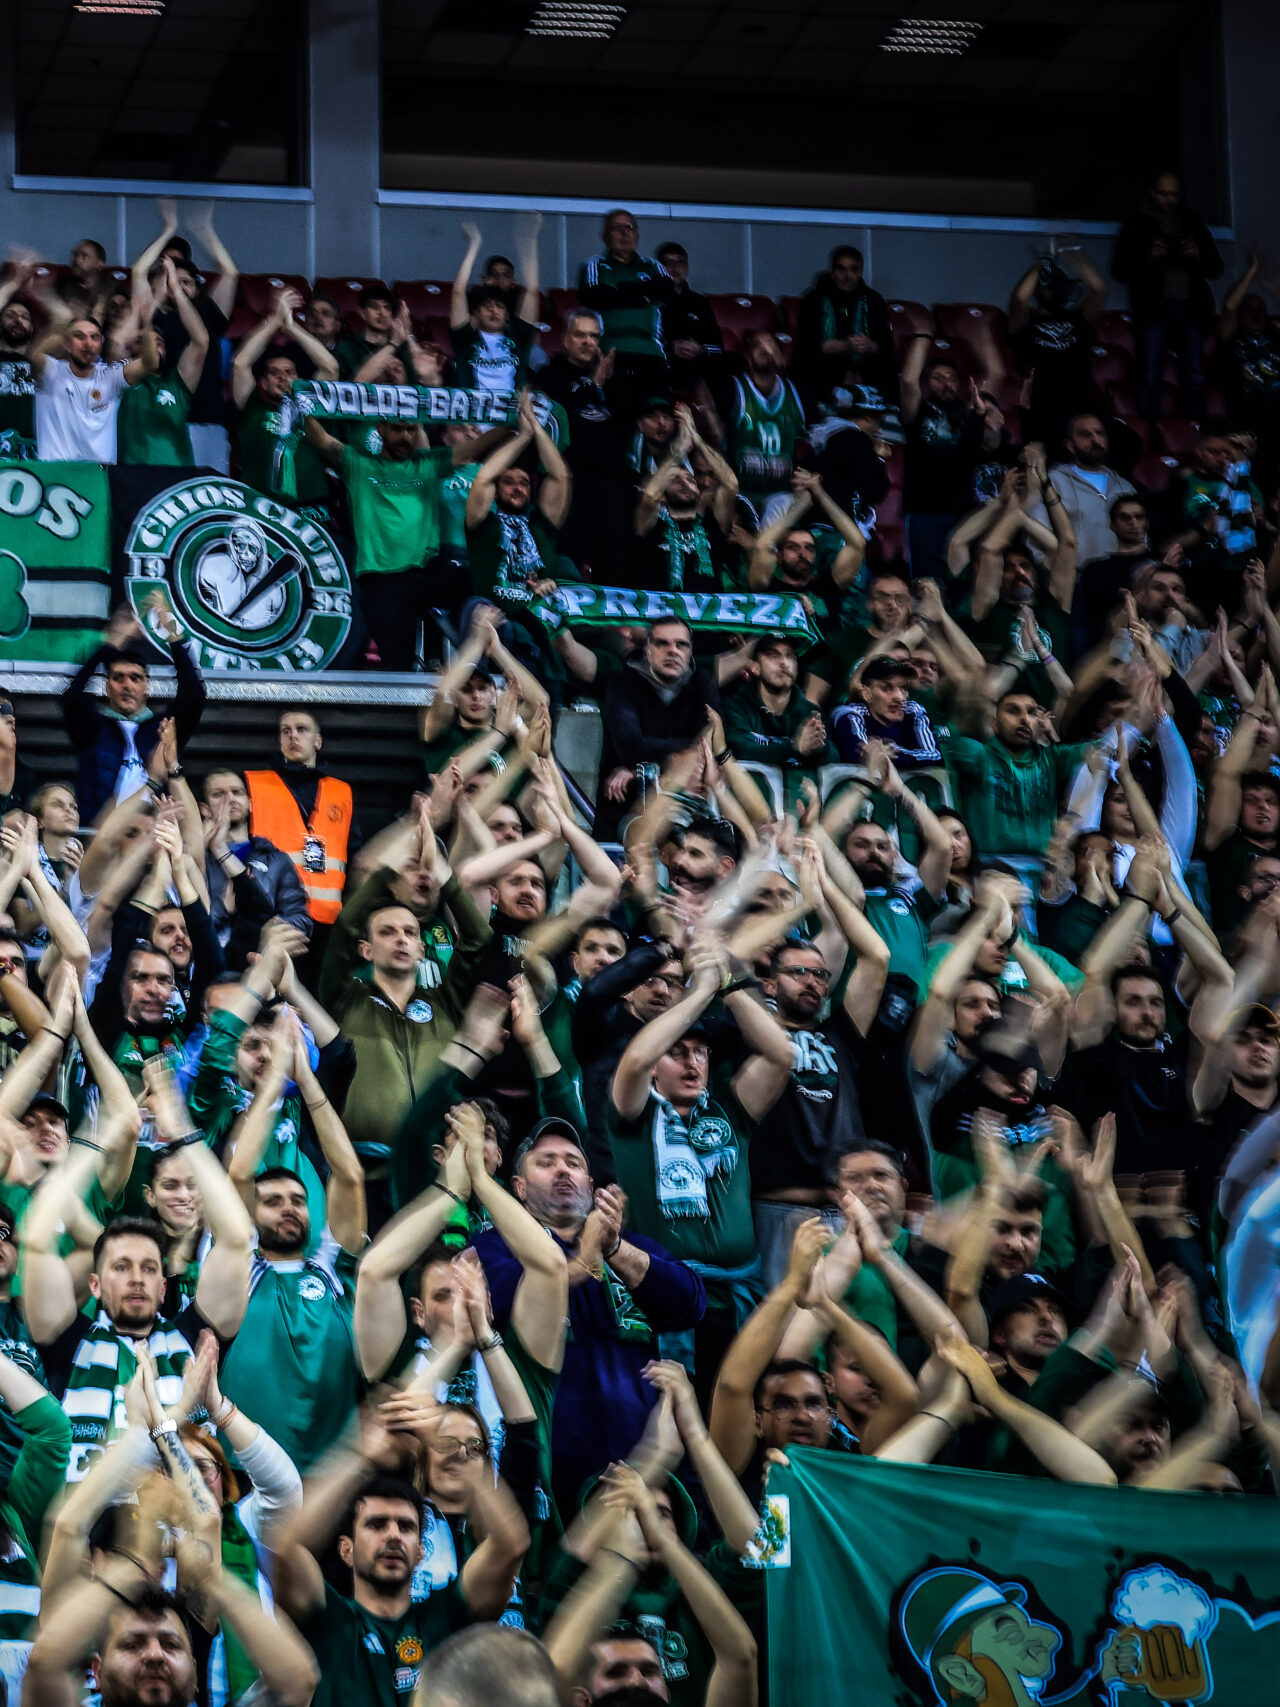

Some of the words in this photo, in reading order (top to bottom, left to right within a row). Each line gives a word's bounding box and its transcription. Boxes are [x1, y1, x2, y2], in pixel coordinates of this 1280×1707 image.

[311, 380, 419, 419] VOLOS
[430, 384, 511, 423] GATE
[140, 484, 247, 550] CHIOS
[255, 498, 342, 582] CLUB
[128, 557, 166, 578] 19
[311, 590, 352, 615] 96
[563, 586, 811, 631] PREVEZA
